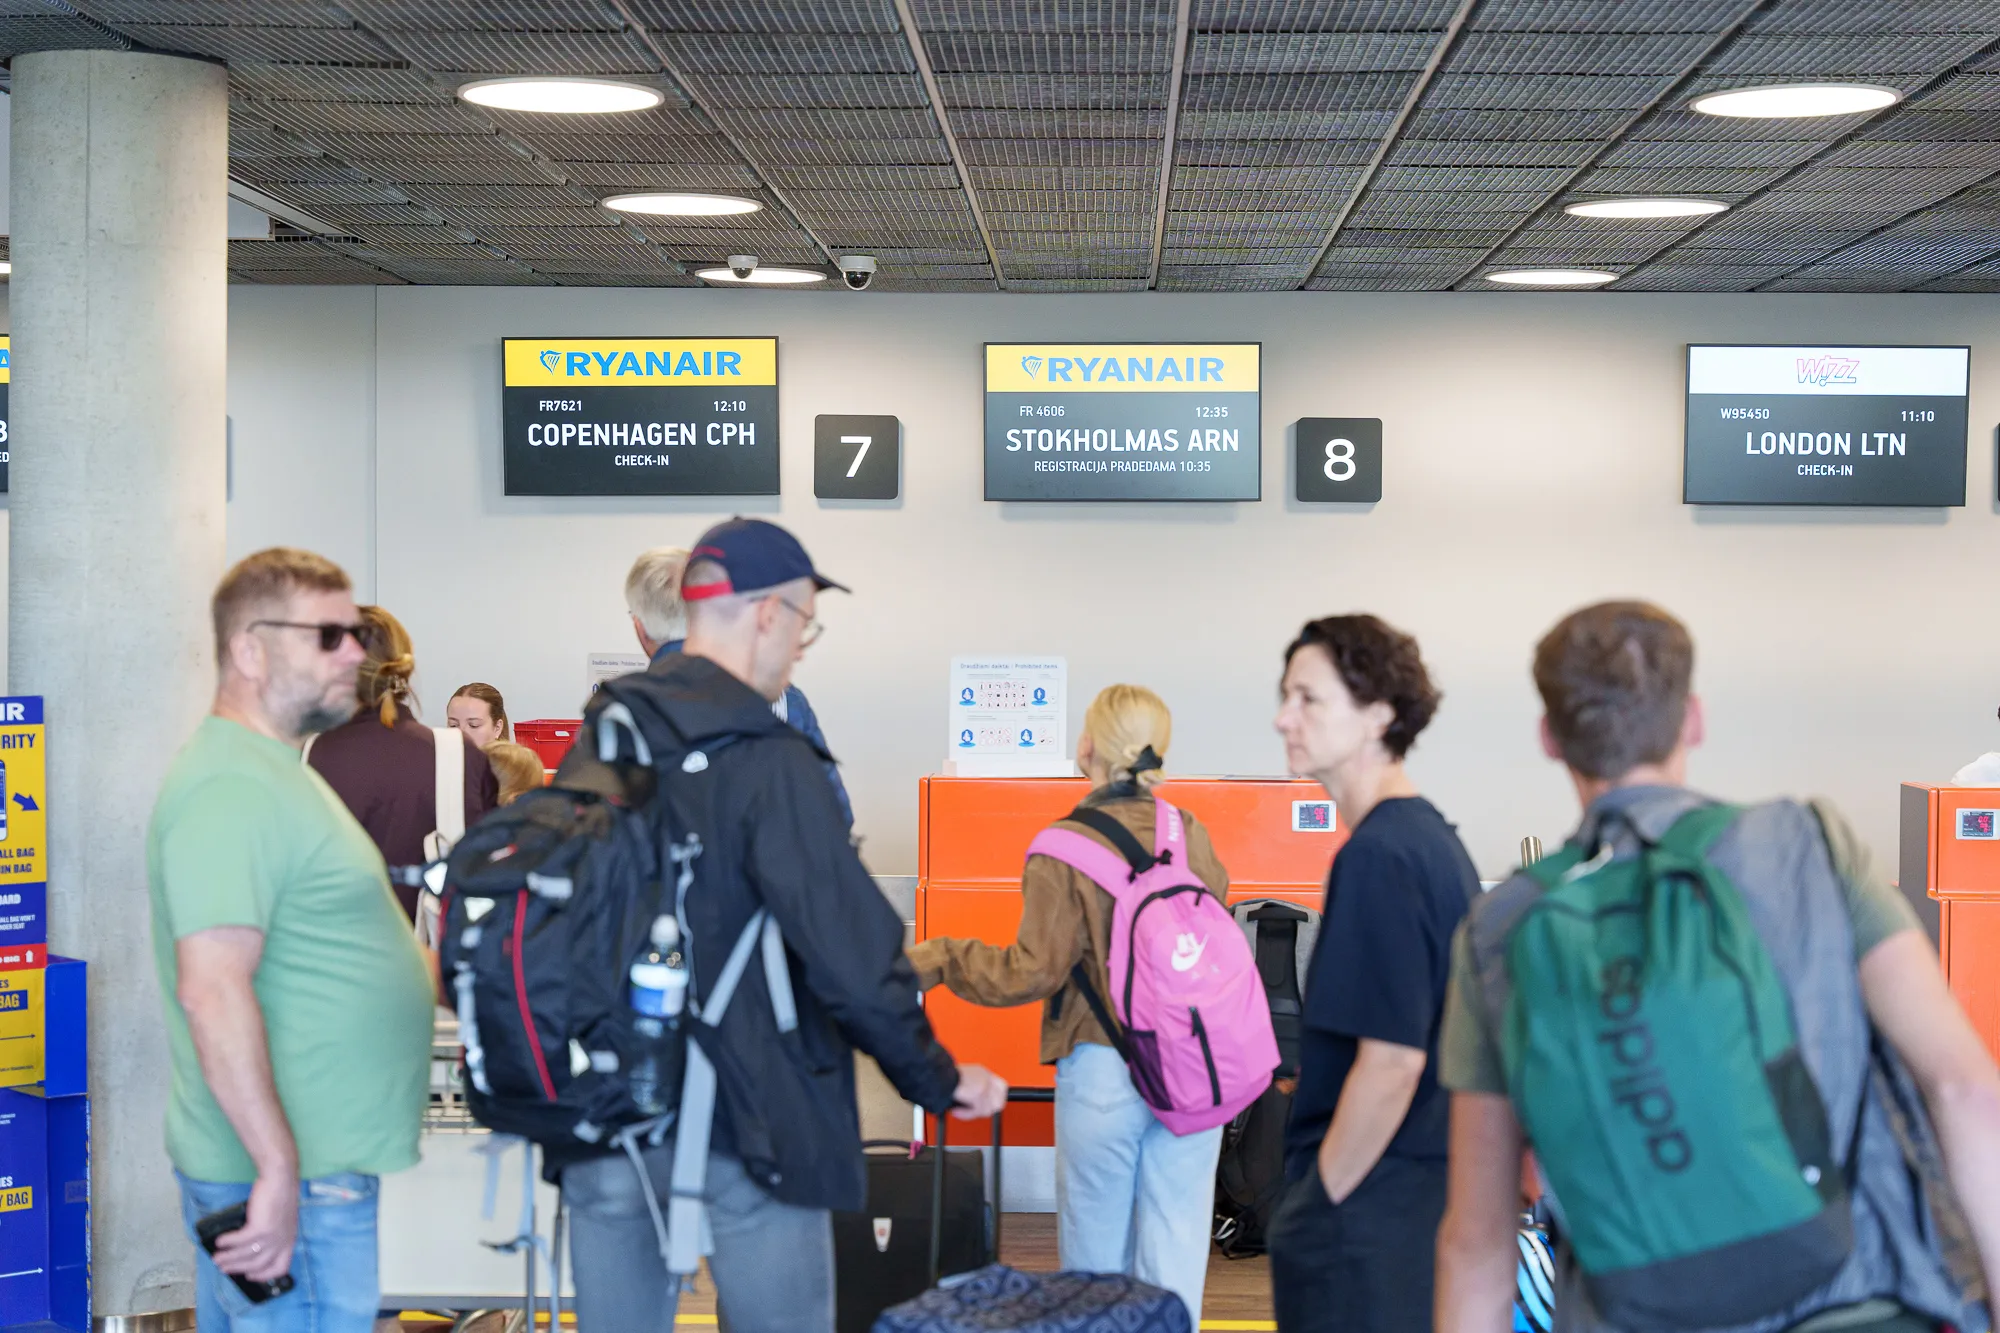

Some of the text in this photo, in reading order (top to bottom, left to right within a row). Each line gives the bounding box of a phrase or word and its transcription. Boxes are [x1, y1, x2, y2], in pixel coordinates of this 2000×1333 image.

[565, 351, 742, 376] RYANAIR
[1047, 357, 1225, 382] RYANAIR
[539, 400, 582, 412] FR7621
[713, 400, 747, 412] 12:10
[1019, 405, 1065, 417] FR 4606
[1195, 406, 1229, 418] 12:35
[1720, 407, 1770, 419] W95450
[1901, 410, 1935, 422] 11:10
[527, 422, 756, 447] COPENHAGEN CPH
[1005, 428, 1239, 453] STOKHOLMAS ARN
[1746, 431, 1906, 456] LONDON LTN
[614, 454, 669, 467] CHECK-IN
[840, 435, 872, 478] 7
[1323, 438, 1357, 482] 8
[1034, 460, 1211, 474] REGISTRACIJA PRADEDAMA 10:35
[1797, 464, 1853, 476] CHECK-IN
[1599, 955, 1694, 1176] adidas
[6, 1191, 29, 1207] BAG
